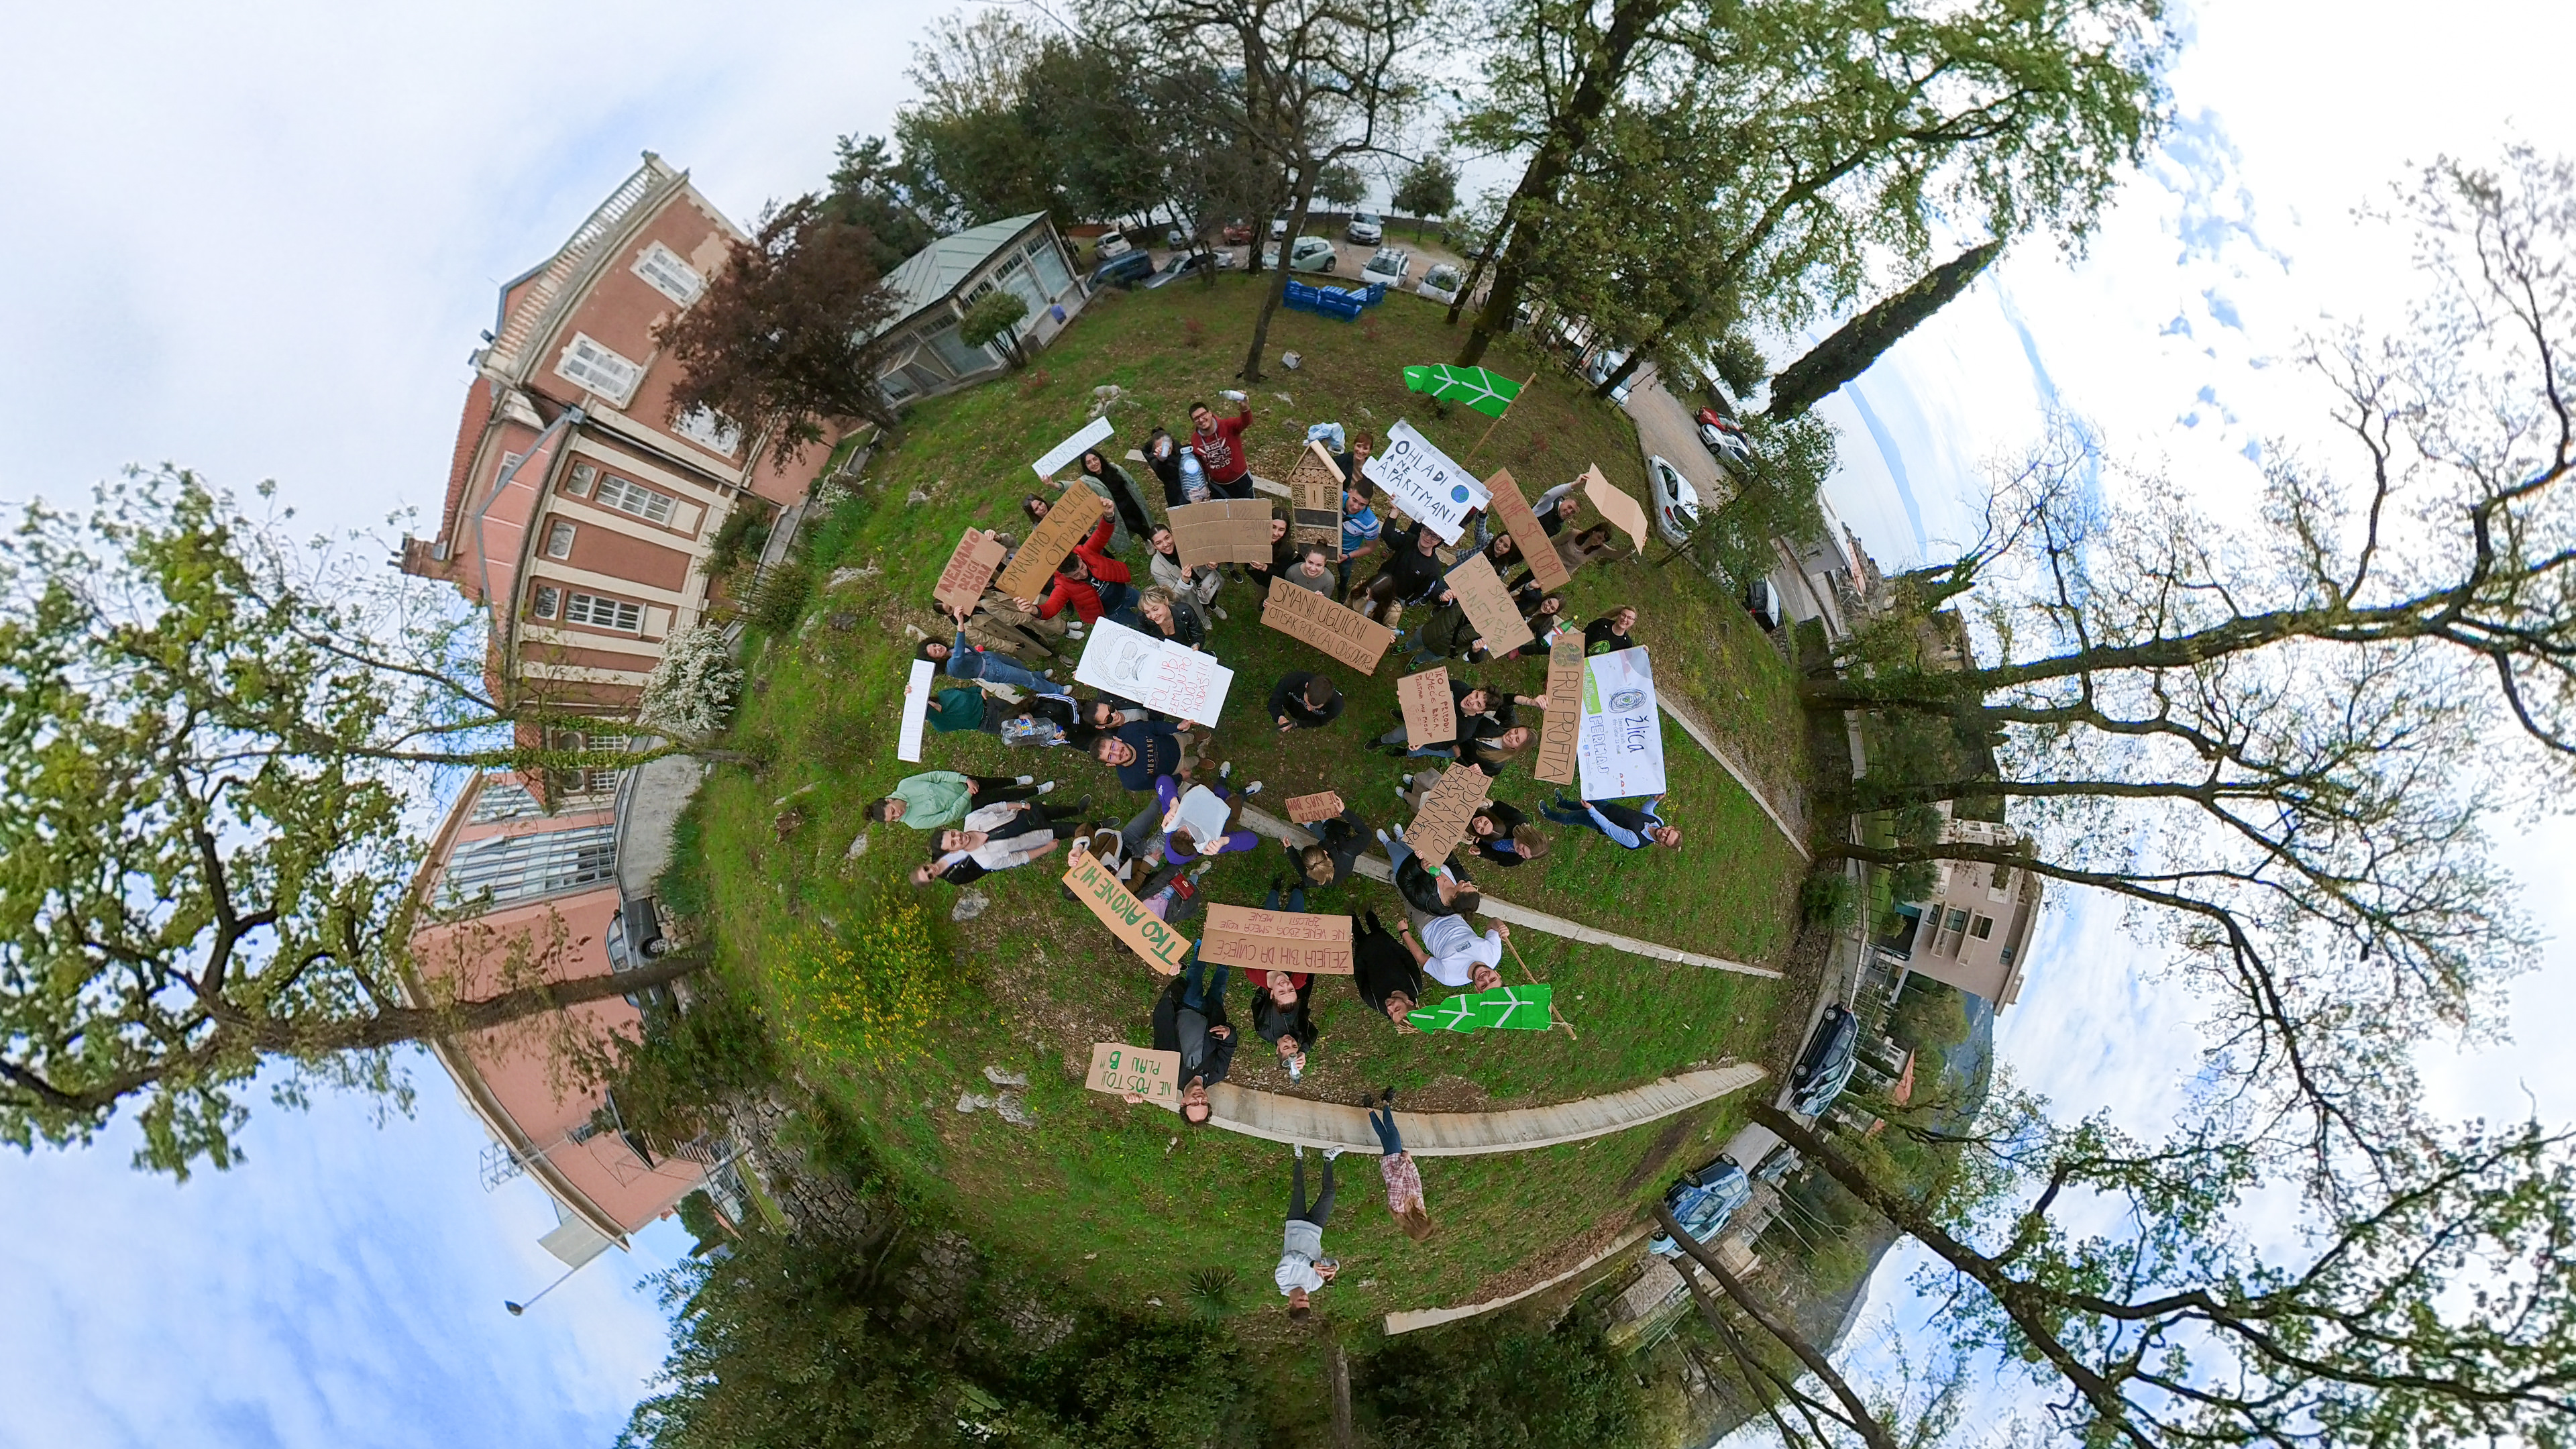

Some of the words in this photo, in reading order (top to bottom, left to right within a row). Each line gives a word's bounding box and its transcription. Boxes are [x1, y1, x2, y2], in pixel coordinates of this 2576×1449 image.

[1387, 453, 1395, 462] A
[1397, 460, 1410, 475] NE
[1395, 440, 1448, 486] OHLADI
[1375, 462, 1456, 526] APARTMAN!
[1487, 473, 1528, 524] VRIJEME
[1515, 522, 1542, 546] SE
[1530, 542, 1560, 580] TOPI
[957, 560, 979, 590] DRUGI
[1002, 531, 1051, 592] SMANJIMO
[969, 564, 992, 594] DOM
[1454, 570, 1495, 629] PLANETA
[1472, 557, 1492, 579] SVI
[1487, 584, 1511, 612] SMO
[1509, 619, 1525, 637] MI
[1300, 621, 1335, 651] POVEĆAJ
[1318, 602, 1368, 641] UGLJIČNI
[1148, 650, 1181, 708] POLJUBI
[1169, 674, 1187, 714] ZEMLJU
[1179, 657, 1192, 672] PO
[1425, 672, 1437, 704] SMEĆE
[1434, 667, 1446, 685] TKO
[1551, 671, 1580, 706] PRIJE
[1180, 682, 1198, 713] KOJOJ
[1420, 704, 1426, 712] MU
[1539, 710, 1576, 779] PROFITA
[1589, 714, 1609, 773] FERMAJ
[1624, 714, 1650, 754] Žlica
[1424, 763, 1463, 813] RAZINU
[1286, 798, 1303, 811] DOM
[1298, 806, 1340, 822] PLANETA
[1432, 772, 1489, 855] PODIGNIMO
[1437, 802, 1451, 812] A
[1405, 814, 1430, 845] MORA
[1428, 814, 1444, 838] NE
[1220, 921, 1240, 930] KOJE
[1248, 912, 1275, 922] MENE
[1289, 916, 1322, 930] ŽALOSTI
[1141, 920, 1176, 965] TKO
[1213, 938, 1256, 961] CVIJEĆE
[1332, 930, 1345, 941] NE
[1260, 946, 1275, 965] DA
[1281, 947, 1300, 966] BIH
[1305, 948, 1350, 972] ŽELJELA
[1131, 1057, 1161, 1075] PLAN
[1100, 1071, 1152, 1095] POSTOJI
[1157, 1081, 1171, 1096] NE
